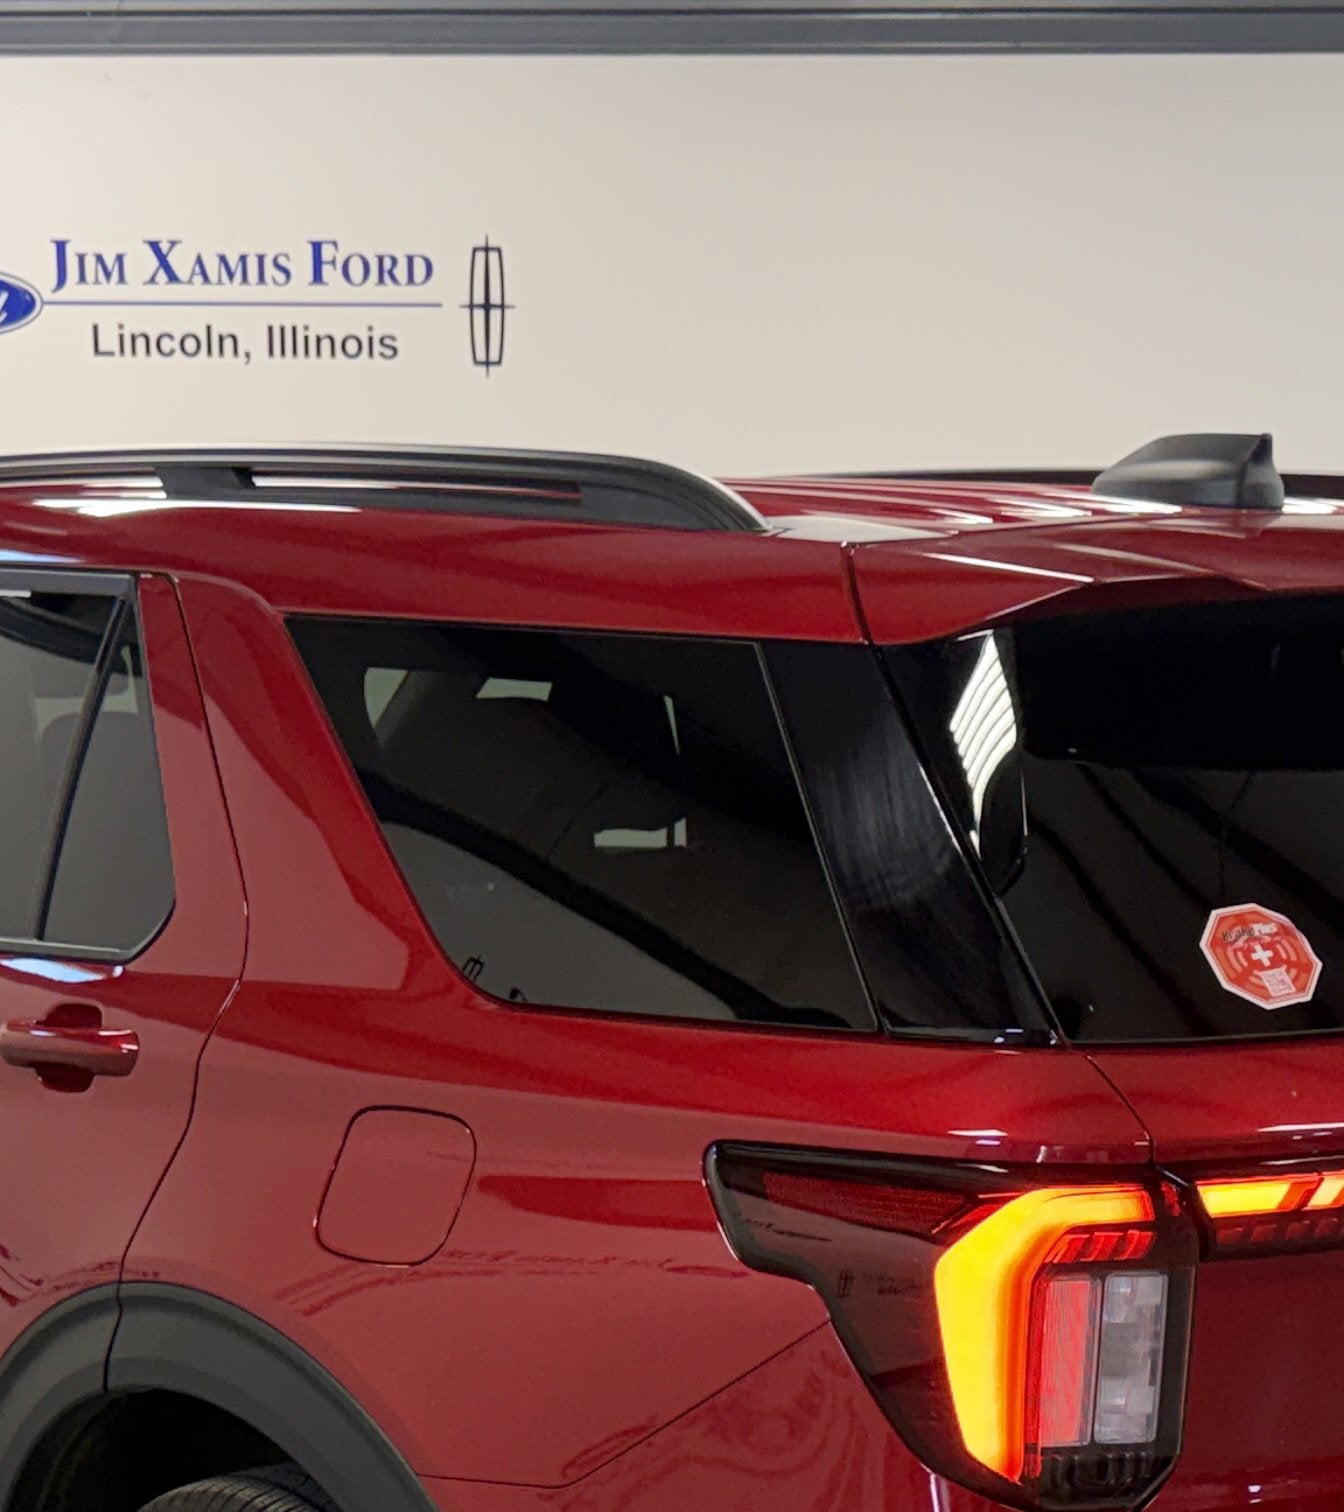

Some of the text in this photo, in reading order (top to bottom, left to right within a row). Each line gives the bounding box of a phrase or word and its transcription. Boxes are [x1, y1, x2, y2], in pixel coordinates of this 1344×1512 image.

[51, 239, 434, 293] JIM XAMIS FORD
[92, 323, 398, 365] Lincoln, Illinois
